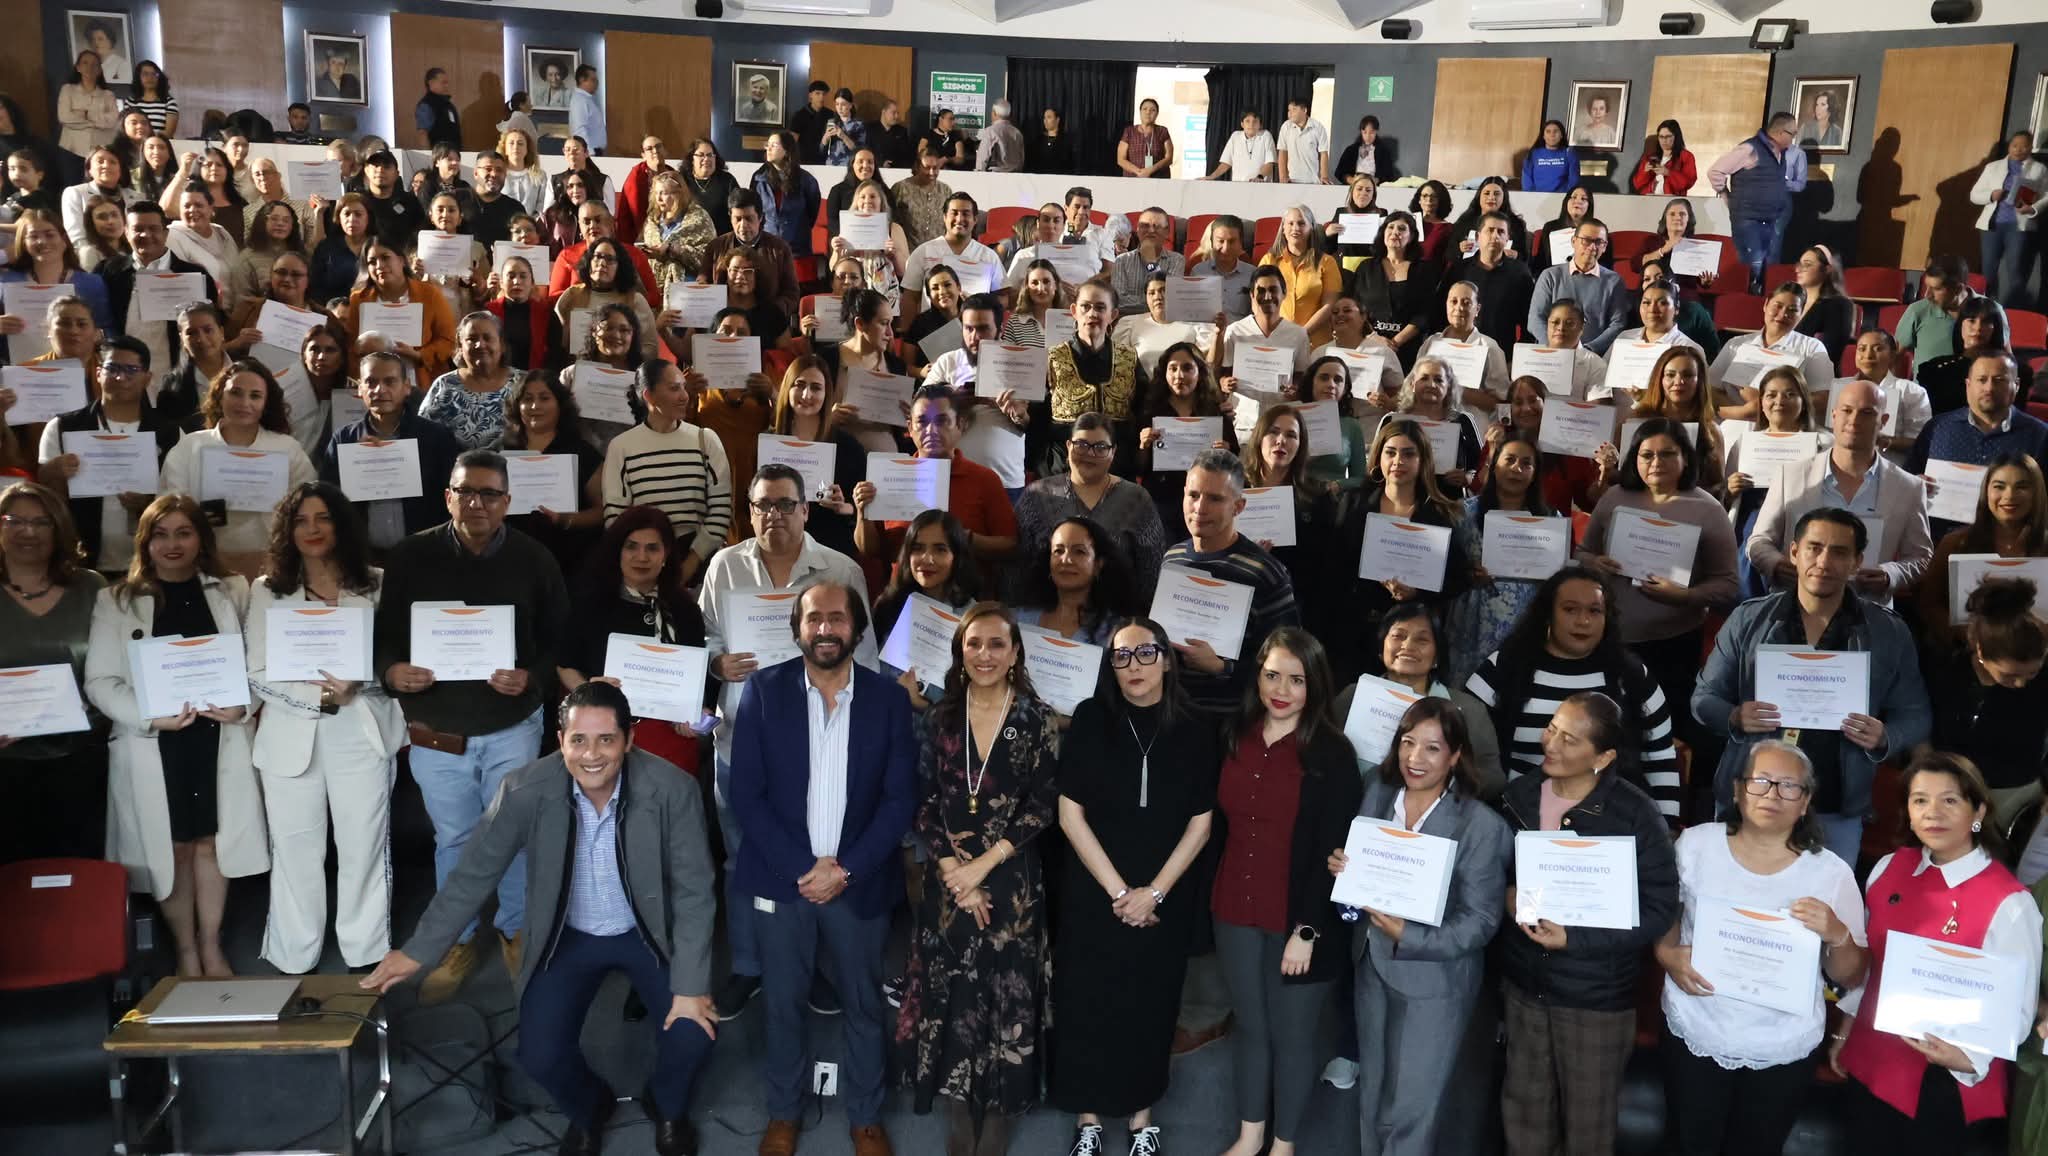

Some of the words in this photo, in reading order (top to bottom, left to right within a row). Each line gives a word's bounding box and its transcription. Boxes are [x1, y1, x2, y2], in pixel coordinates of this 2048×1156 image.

[1497, 533, 1551, 542] RECONOCIMIENTO
[1173, 593, 1230, 611] RECONOCIMIENTO
[160, 656, 227, 670] RECONOCIMIENTO
[623, 662, 684, 677] RECONOCIMIENTO
[1029, 654, 1083, 672] RECONOCIMIENTO
[1777, 673, 1847, 683] RECONOCIMIENTO
[1361, 847, 1426, 867] RECONOCIMIENTO
[1538, 863, 1611, 874] RECONOCIMIENTO
[1718, 930, 1793, 953] RECONOCIMIENTO
[1911, 967, 1995, 992] RECONOCIMIENTO
